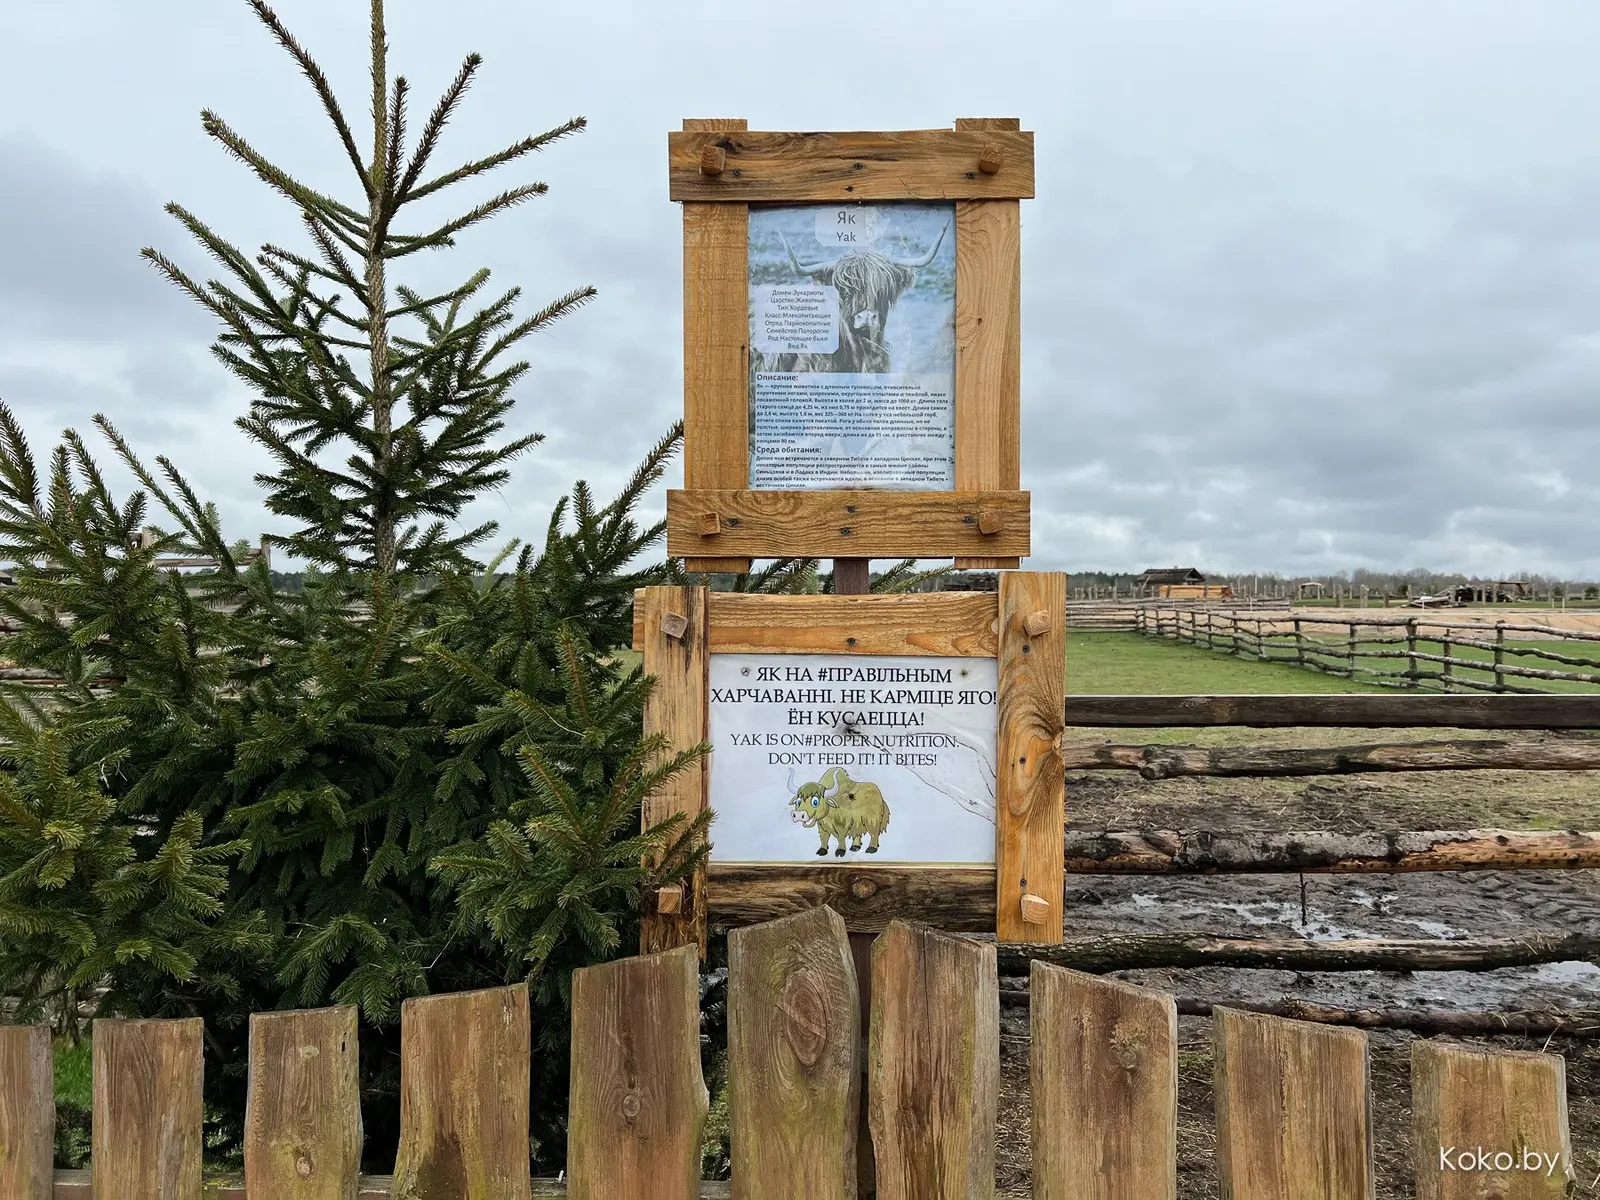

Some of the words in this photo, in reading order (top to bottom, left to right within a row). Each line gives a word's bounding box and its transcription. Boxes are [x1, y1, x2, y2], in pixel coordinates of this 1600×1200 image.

[838, 211, 856, 224] Як
[836, 232, 856, 242] Yak
[756, 667, 781, 681] ЯК
[785, 668, 813, 682] НА
[818, 668, 952, 683] #ПРАВІЛЬНЫМ
[711, 689, 836, 703] ХАРЧАВАННІ.
[840, 689, 865, 703] НЕ
[870, 690, 953, 707] КАРМІЦЕ
[957, 690, 996, 705] ЯГО!
[788, 708, 813, 725] ЁН
[817, 711, 924, 728] КУСАЕЦЦА!
[730, 734, 762, 745] YAK
[766, 734, 778, 745] IS
[872, 735, 959, 748] NUTRITION.
[769, 752, 815, 764] DON'T
[818, 753, 854, 765] FEED
[858, 753, 875, 765] IT!
[878, 754, 892, 765] IT
[896, 754, 937, 766] BITES!
